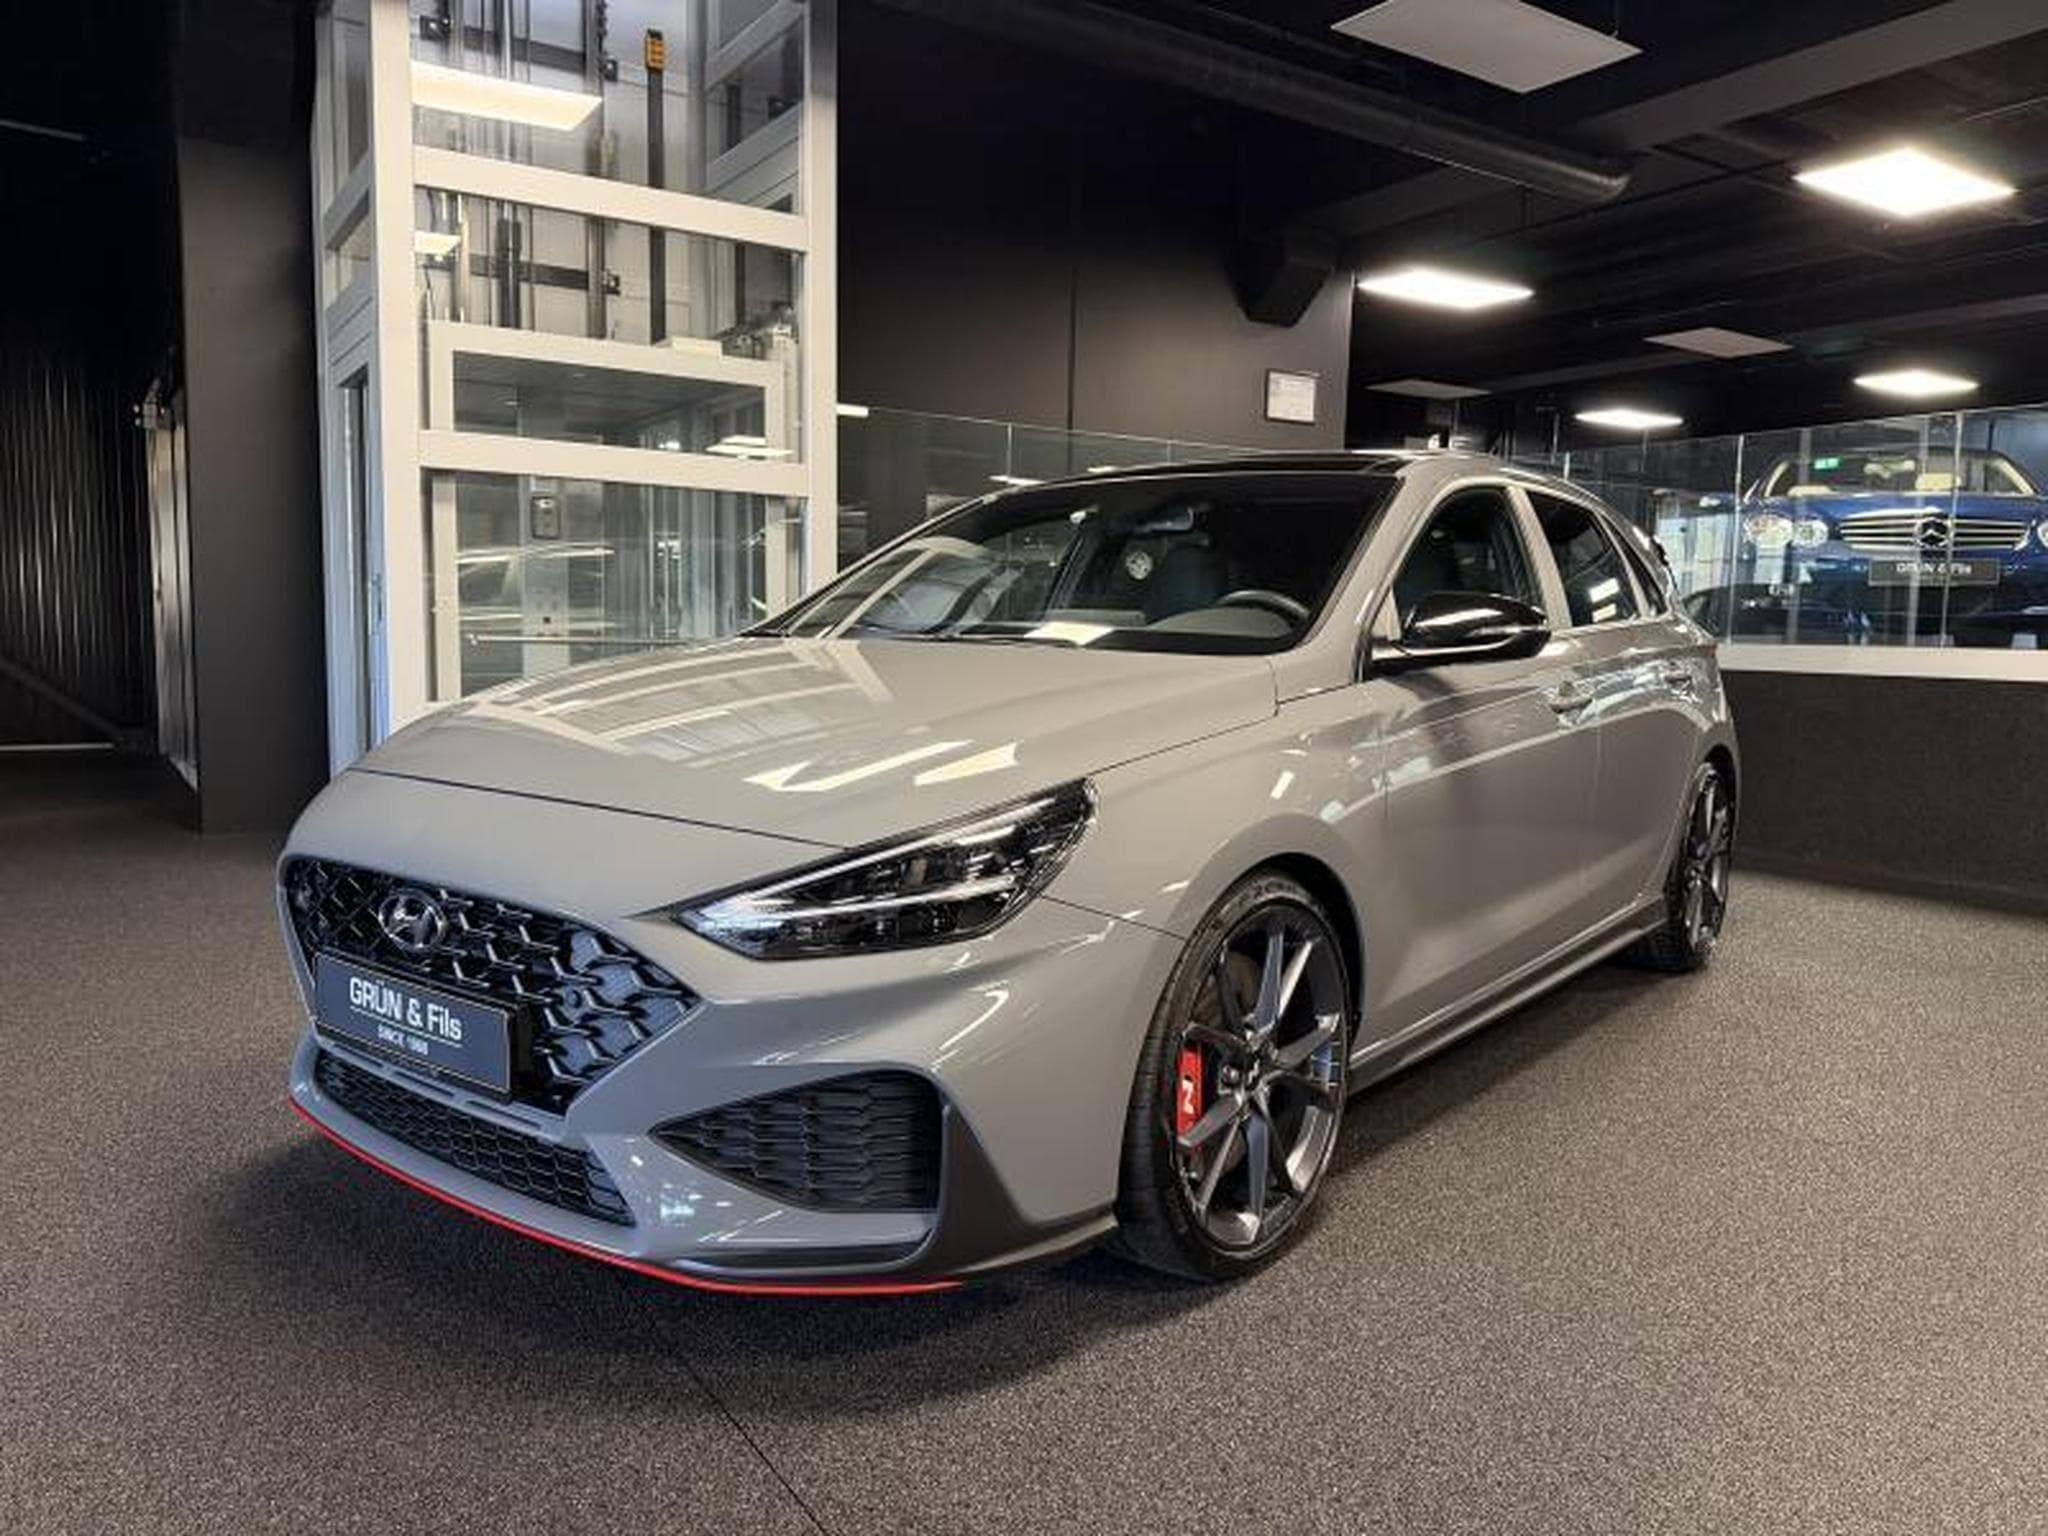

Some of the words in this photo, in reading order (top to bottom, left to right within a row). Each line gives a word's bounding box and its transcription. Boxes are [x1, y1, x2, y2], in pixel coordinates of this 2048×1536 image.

[350, 977, 402, 1021] GRÜN
[407, 998, 424, 1028] &
[427, 1003, 462, 1041] Fils
